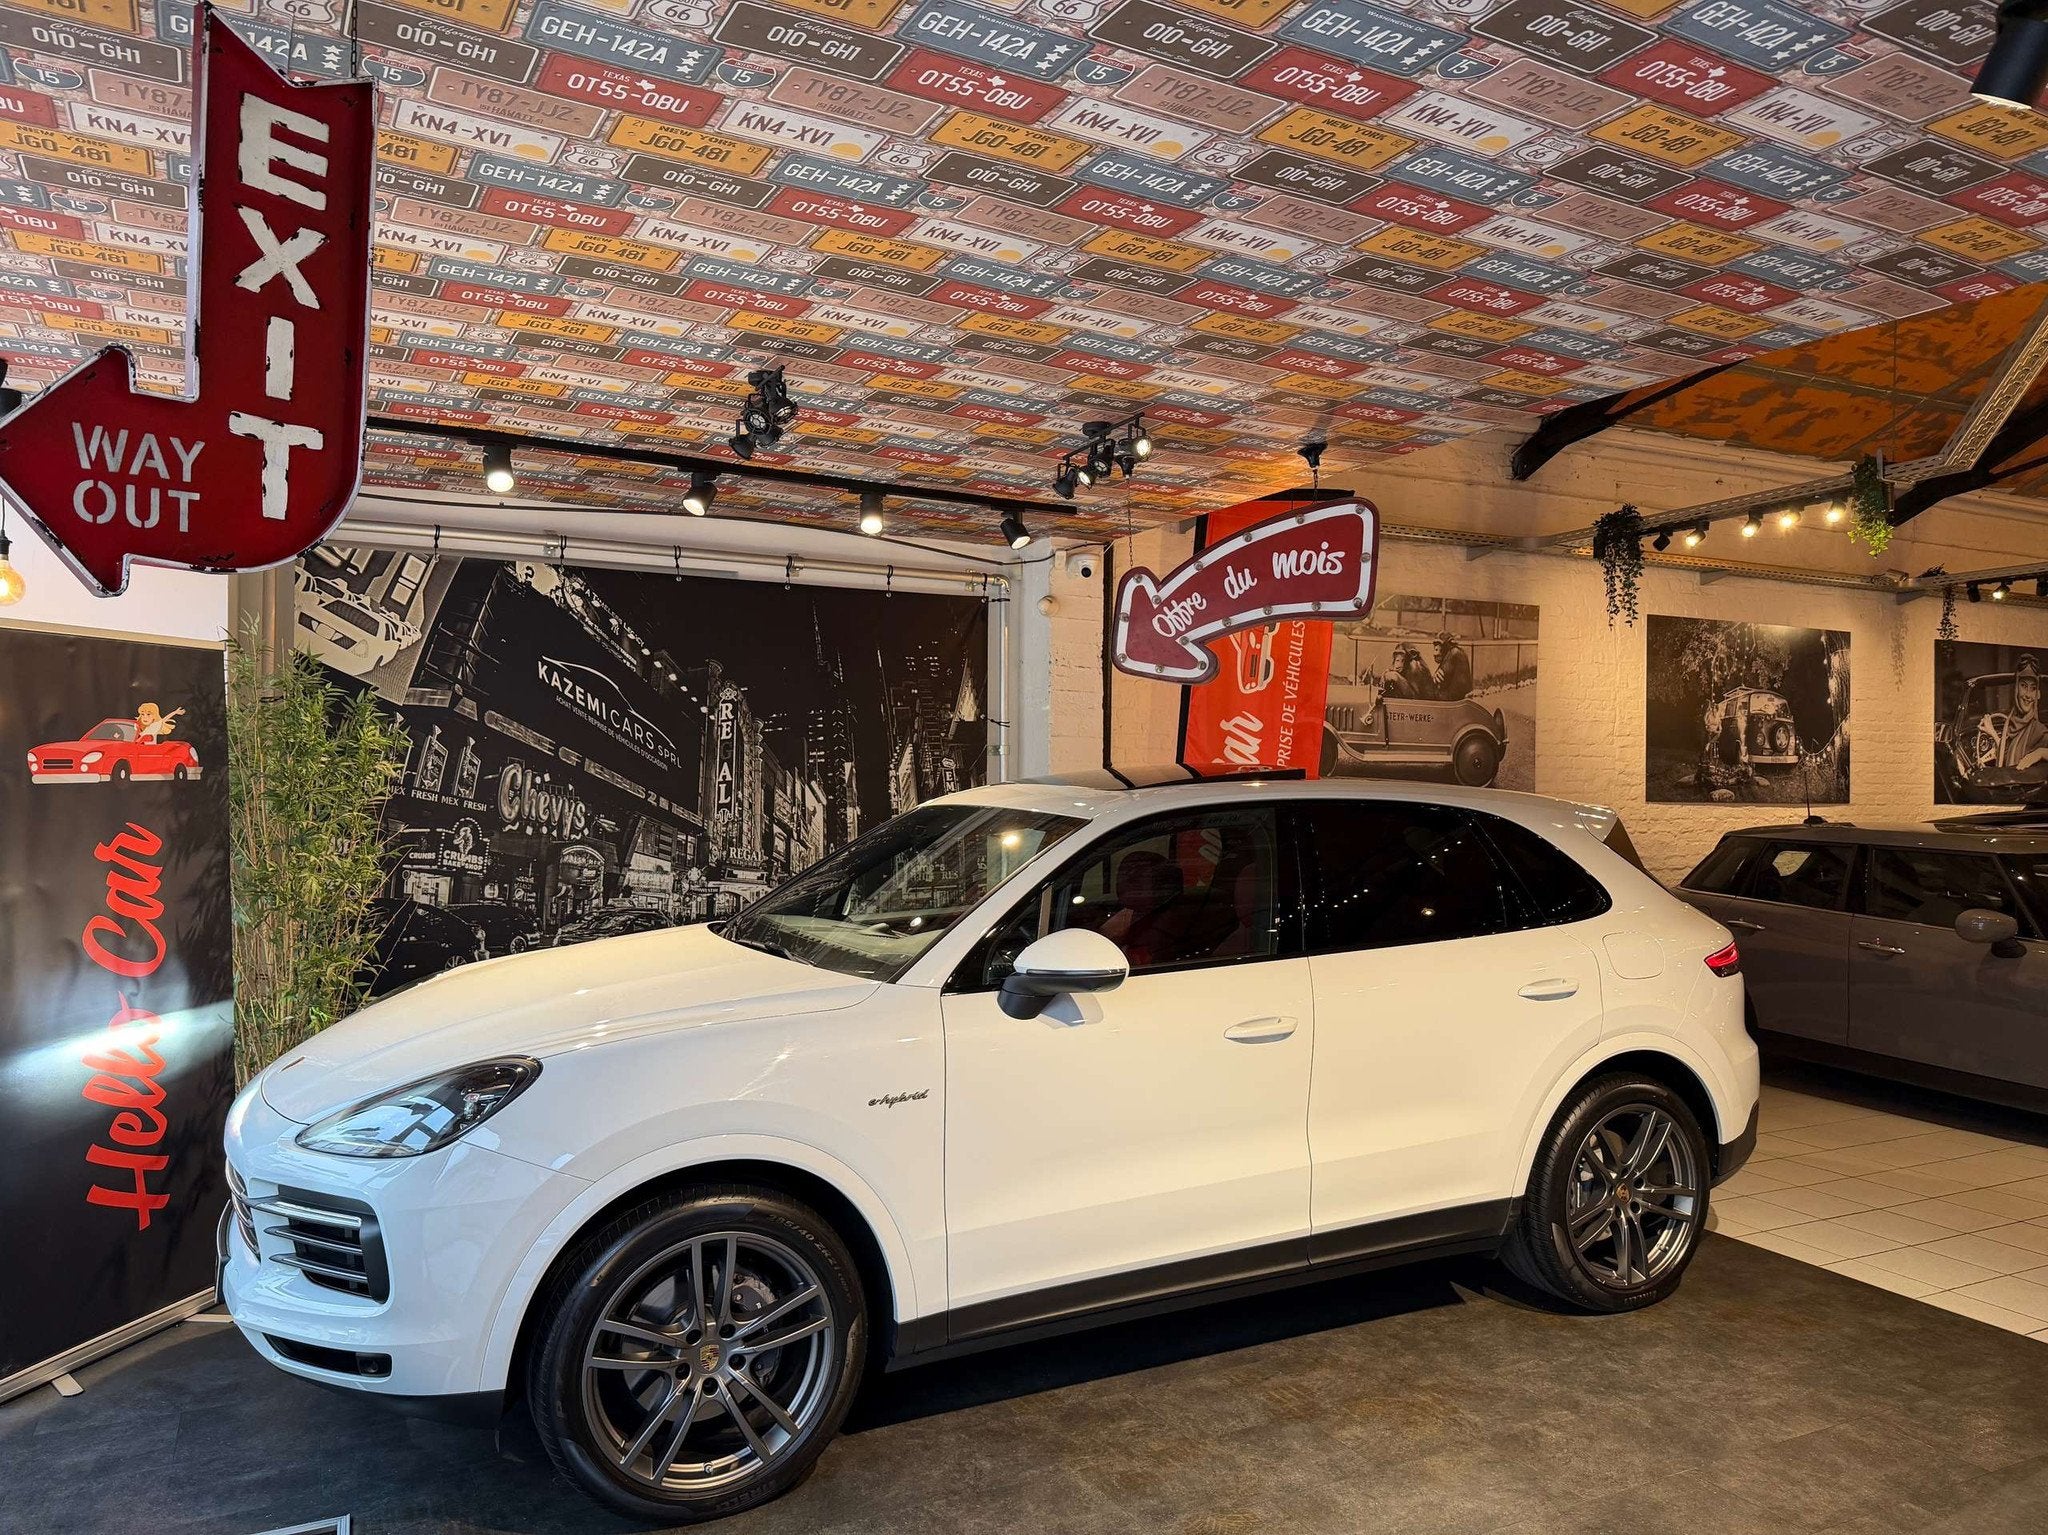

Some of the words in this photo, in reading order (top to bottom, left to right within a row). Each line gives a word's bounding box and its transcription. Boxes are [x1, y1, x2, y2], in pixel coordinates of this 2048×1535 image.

[665, 2, 692, 17] 66
[38, 69, 58, 83] 15
[383, 67, 402, 82] 15
[602, 70, 632, 82] TEXAS
[732, 69, 754, 83] 15
[957, 66, 986, 78] TEXAS
[1087, 65, 1113, 79] 15
[1317, 62, 1347, 74] TEXAS
[1448, 59, 1478, 73] 15
[16, 126, 54, 136] NEW
[64, 135, 109, 147] YORK
[659, 125, 693, 136] NEW
[700, 135, 738, 146] YORK
[988, 122, 1020, 132] NEW
[1026, 131, 1060, 143] YORK
[1321, 119, 1352, 130] NEW
[1355, 129, 1388, 141] YORK
[579, 156, 599, 166] 66
[889, 154, 912, 164] 66
[1204, 152, 1229, 162] 66
[229, 92, 330, 521] EXIT
[72, 422, 205, 483] WAY
[72, 480, 200, 532] OUT
[1152, 591, 1206, 638] Offre
[1223, 565, 1257, 599] du
[1272, 541, 1345, 579] mois
[1284, 620, 1306, 700] VÉHICULES
[538, 661, 606, 720] KAZEMI
[610, 709, 654, 750] CARS
[658, 746, 682, 769] SPRL
[1282, 702, 1295, 724] DE
[1212, 711, 1263, 765] ar
[718, 702, 734, 804] REGAL
[411, 789, 438, 802] FRESH
[441, 796, 459, 806] MEX
[463, 800, 487, 812] FRESH
[498, 763, 586, 840] Chevys
[729, 847, 765, 861] REGAL
[82, 822, 167, 977] Car
[80, 991, 170, 1231] Hello
